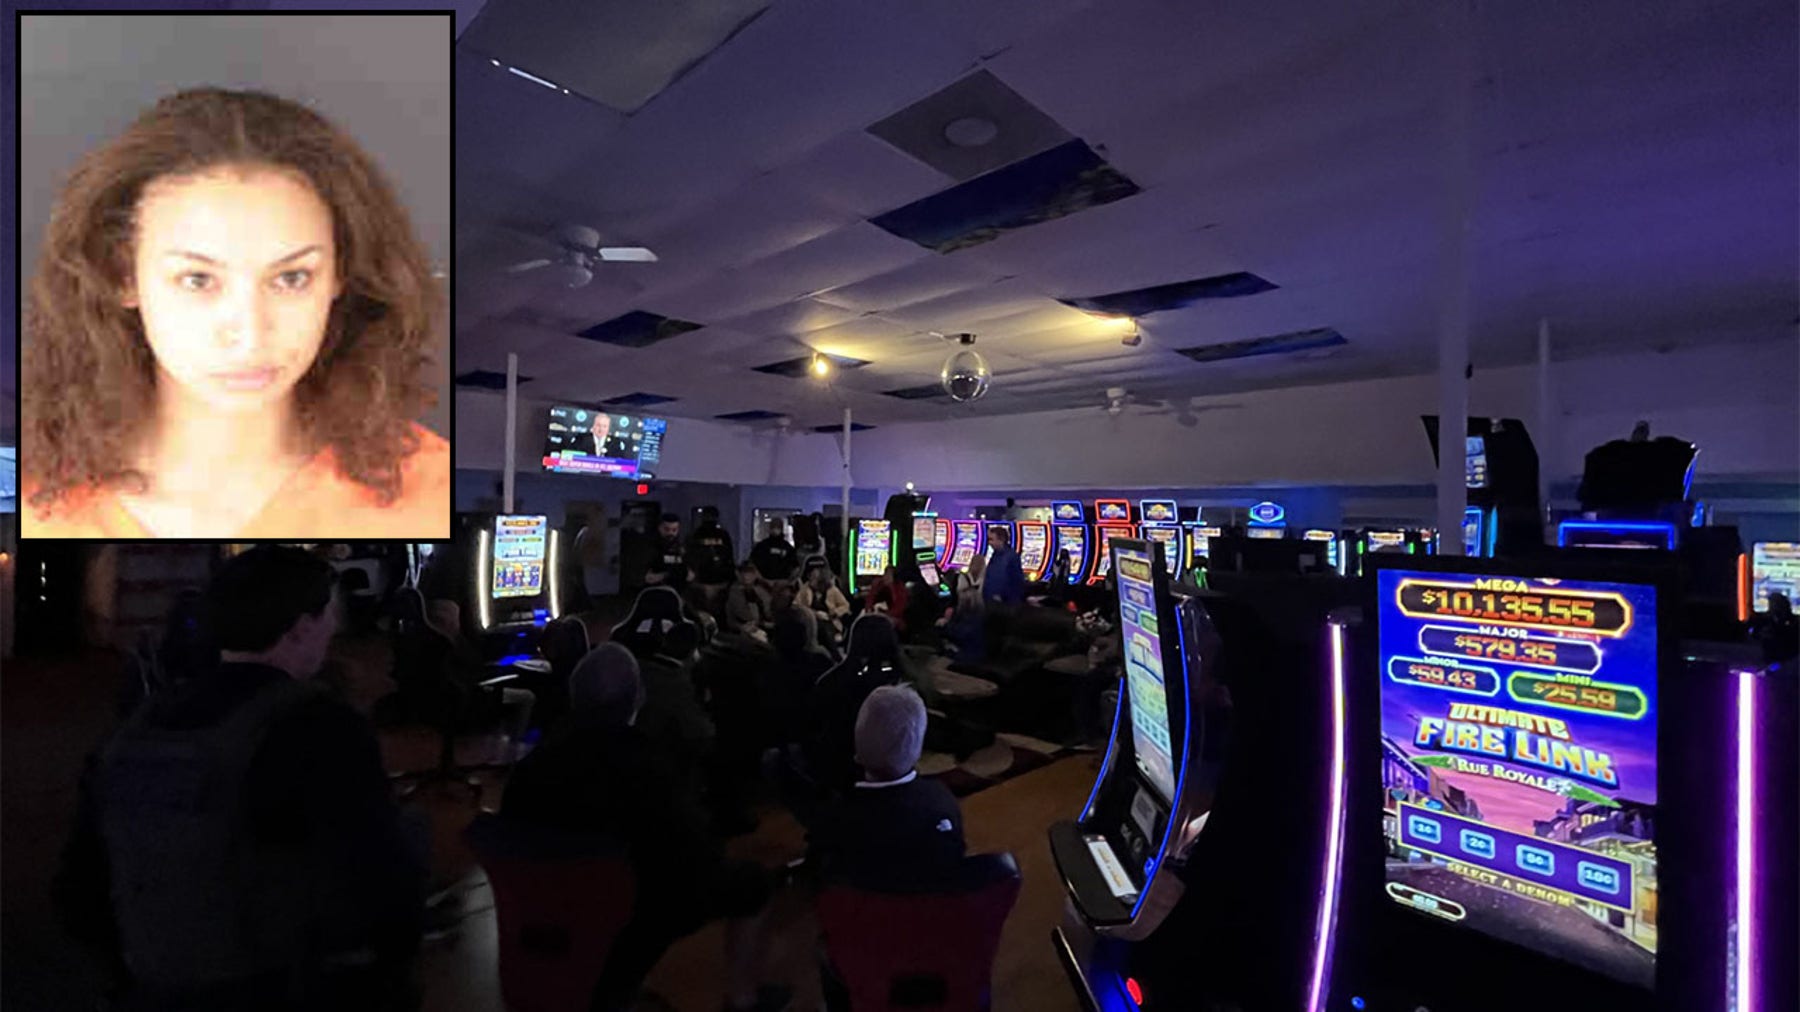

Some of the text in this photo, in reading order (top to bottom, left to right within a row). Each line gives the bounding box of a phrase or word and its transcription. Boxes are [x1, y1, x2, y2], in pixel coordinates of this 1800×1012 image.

[1475, 578, 1530, 593] MEGA
[1422, 588, 1596, 628] $10,135.55
[1454, 634, 1558, 667] $579.35
[1478, 625, 1529, 640] MAJOR
[1449, 702, 1570, 741] ULTIMATE
[1413, 716, 1620, 790] FIRE LINK
[1446, 862, 1573, 908] SELECT A DENOM
